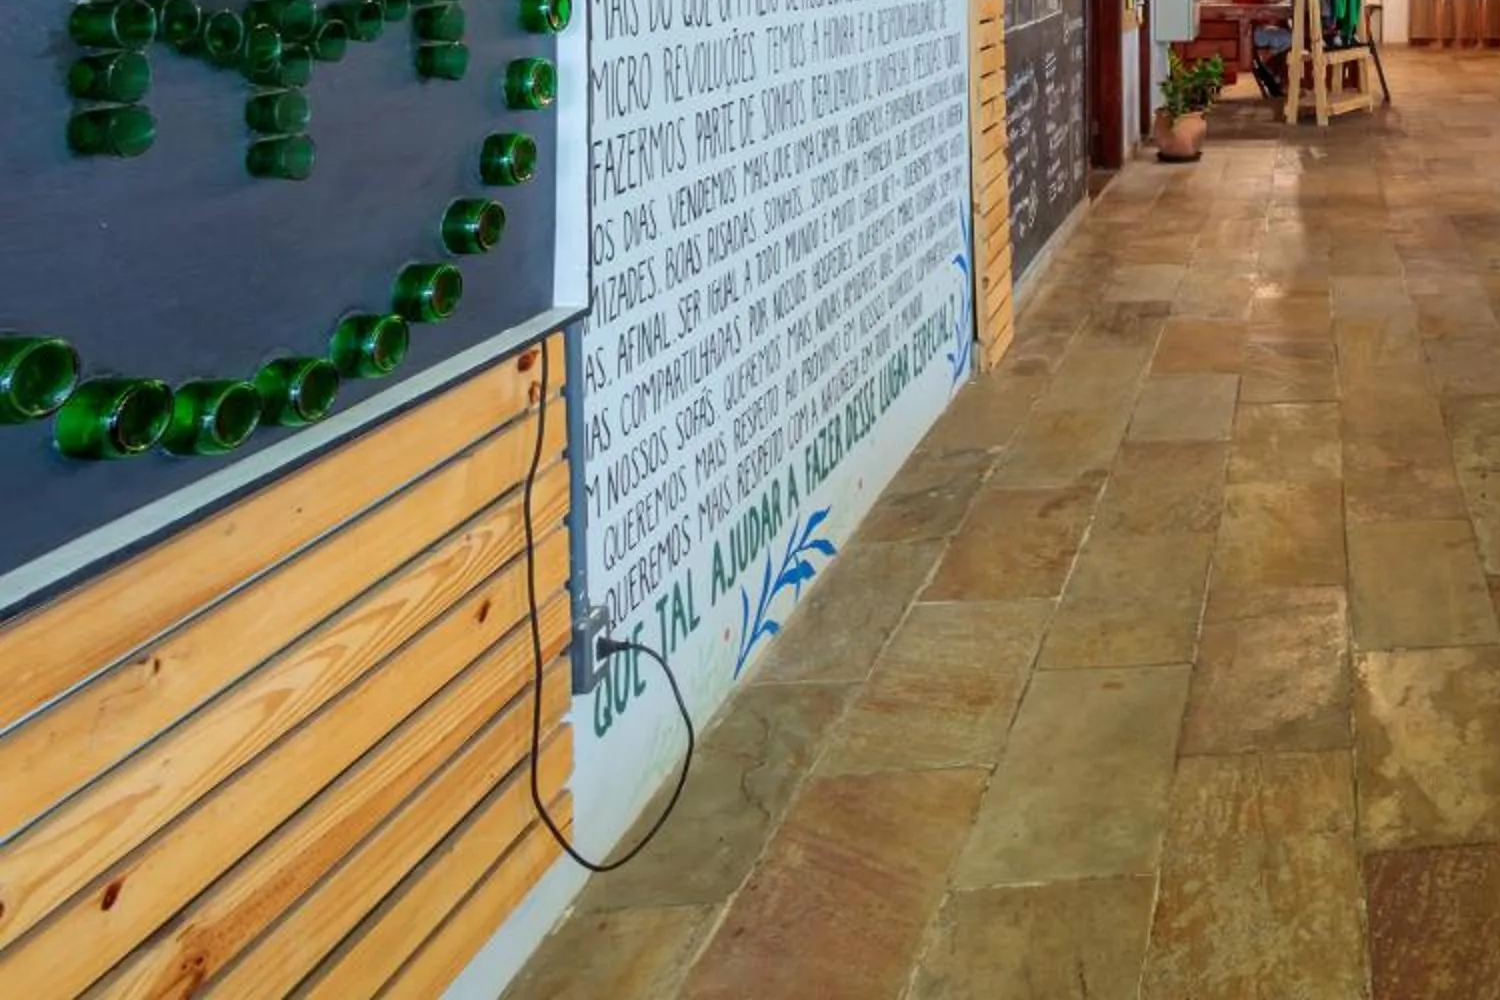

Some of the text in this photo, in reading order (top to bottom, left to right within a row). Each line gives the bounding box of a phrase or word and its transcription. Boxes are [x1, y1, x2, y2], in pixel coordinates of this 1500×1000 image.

[591, 53, 651, 125] MICRO
[591, 115, 686, 206] FAZERMOS
[696, 100, 734, 165] PARTE
[593, 216, 613, 268] OS
[625, 196, 662, 253] DIAS.
[668, 165, 736, 233] VENDEMOS
[667, 233, 701, 290] BOAS
[678, 286, 700, 339] SER
[707, 264, 737, 321] IGUAL
[622, 312, 741, 439] COMPARTILHADAS
[603, 459, 686, 575] QUEREMOS
[695, 425, 726, 491] MAIS
[607, 419, 667, 509] NOSSOS
[607, 513, 690, 636] QUEREMOS
[698, 473, 731, 543] MAIS
[594, 613, 645, 745] QUE
[656, 557, 699, 674] TAL
